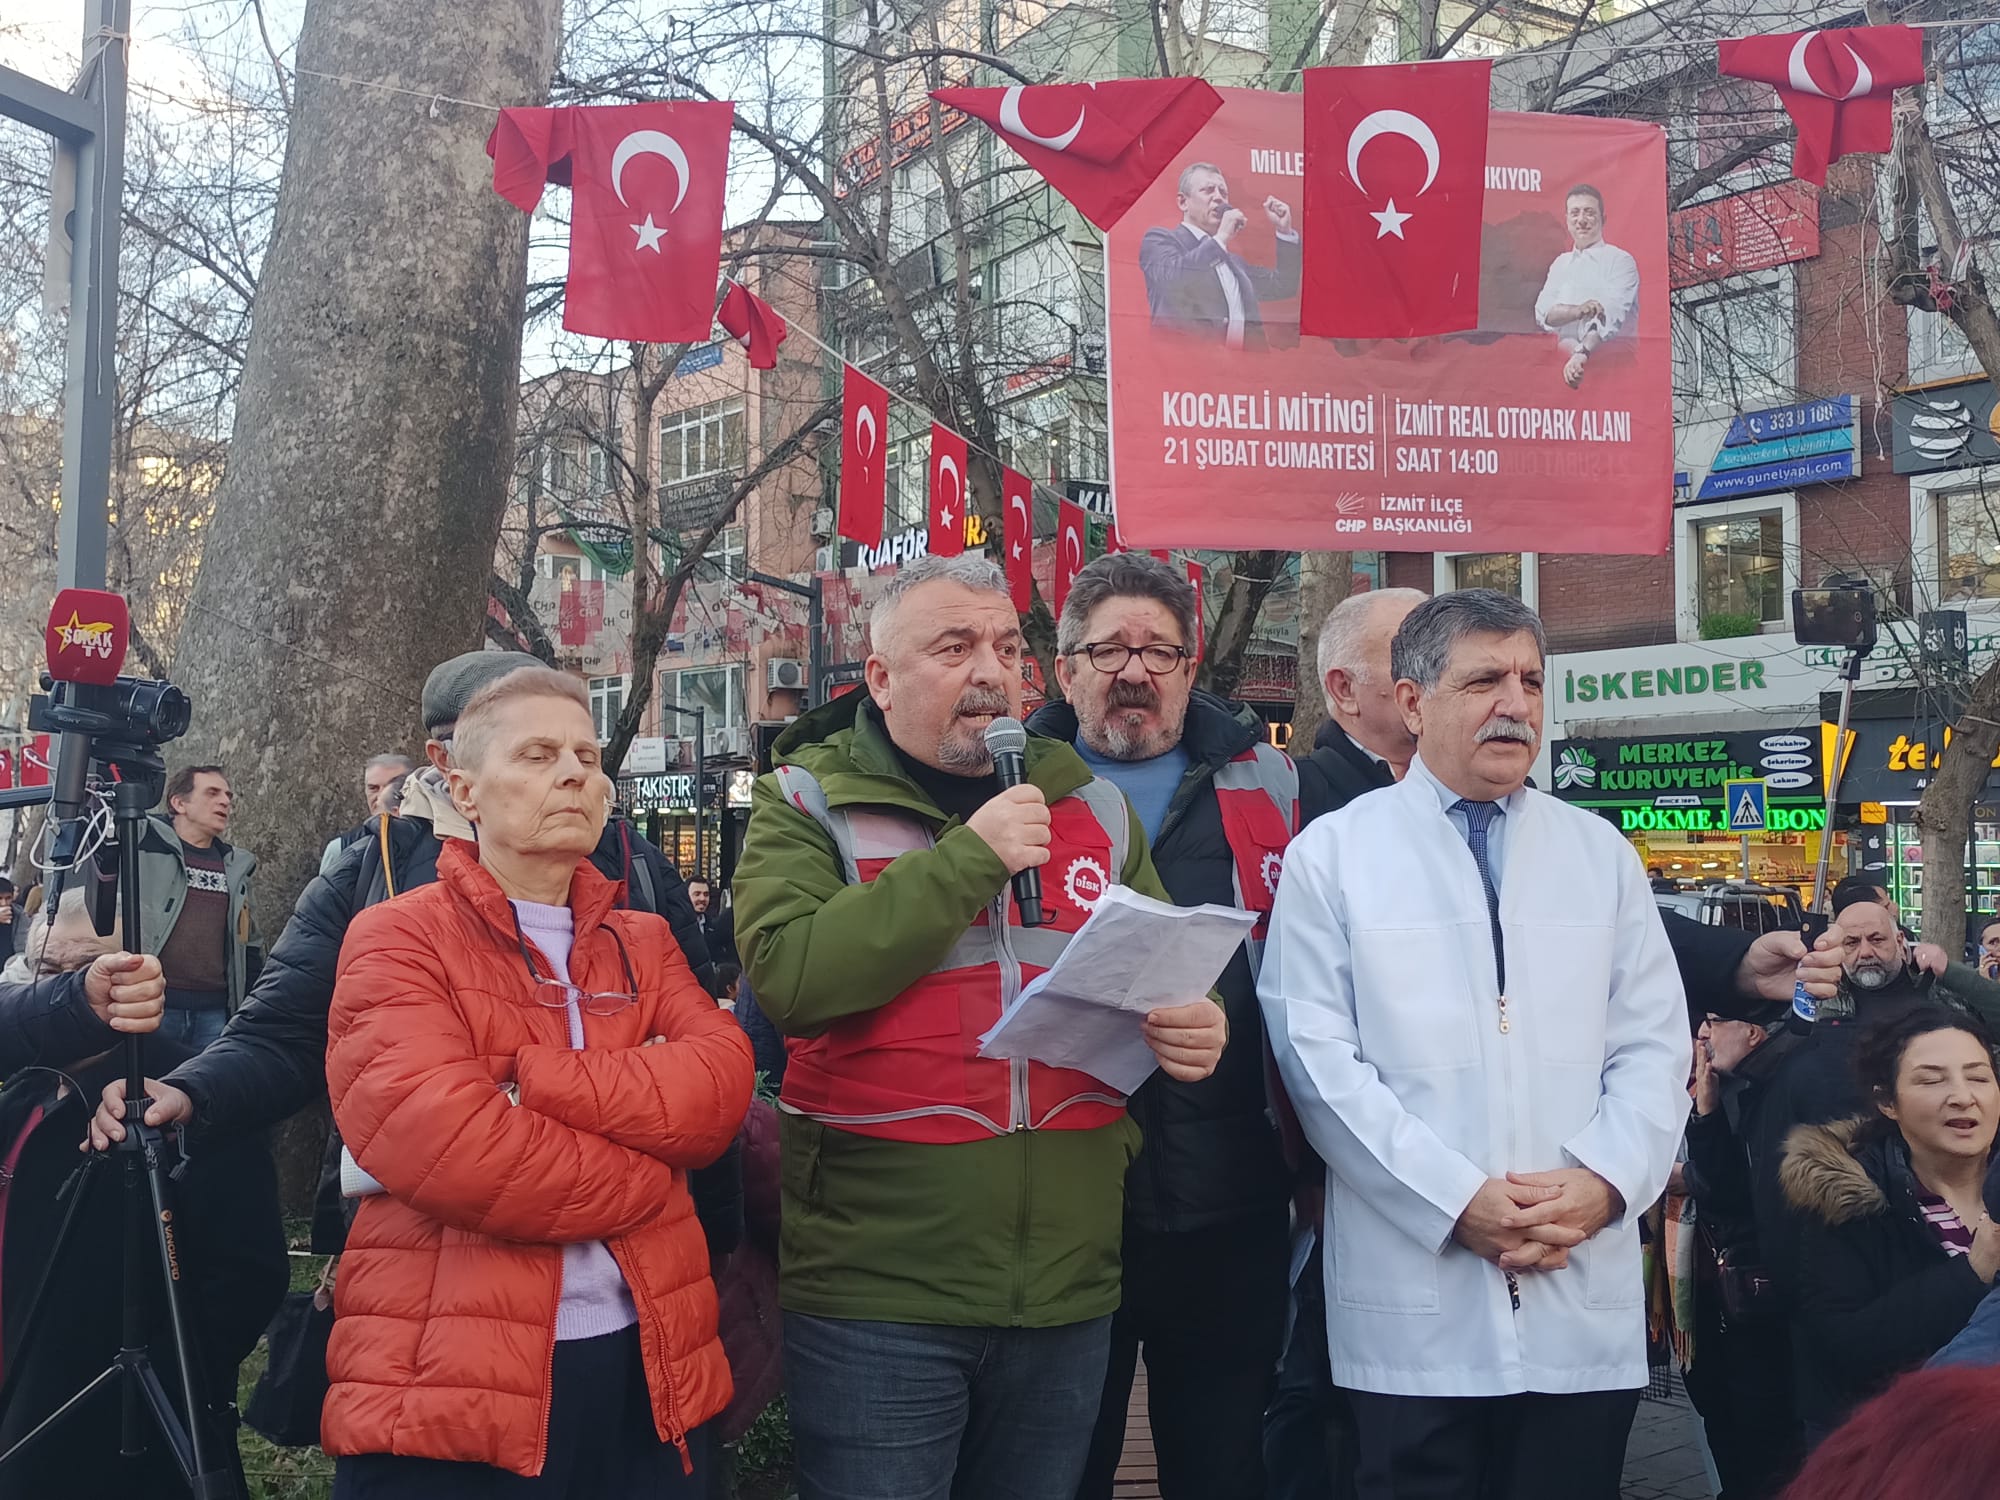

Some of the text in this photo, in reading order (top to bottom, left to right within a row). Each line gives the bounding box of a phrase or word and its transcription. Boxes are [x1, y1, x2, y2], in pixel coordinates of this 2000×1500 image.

[1162, 390, 1375, 434] KOCAELİ MİTİNGİ
[1395, 397, 1631, 442] İZMİT REAL OTOPARK ALANI
[1163, 437, 1375, 471] 21 ŞUBAT CUMARTESİ
[1396, 447, 1499, 474] SAAT 14:00
[1713, 460, 1843, 489] www.gunelyapi.com
[1381, 492, 1463, 516] İZMİT İLÇE
[1335, 519, 1367, 533] CHP
[1372, 515, 1473, 535] BAŞKANLIĞI
[64, 628, 113, 647] SOKAK
[81, 645, 113, 658] TV
[1564, 660, 1768, 703] İSKENDER
[1619, 740, 1729, 765] MERKEZ
[1621, 806, 1713, 831] DÖKME
[1075, 874, 1100, 893] DİSK
[165, 1225, 181, 1281] VANGUARD
